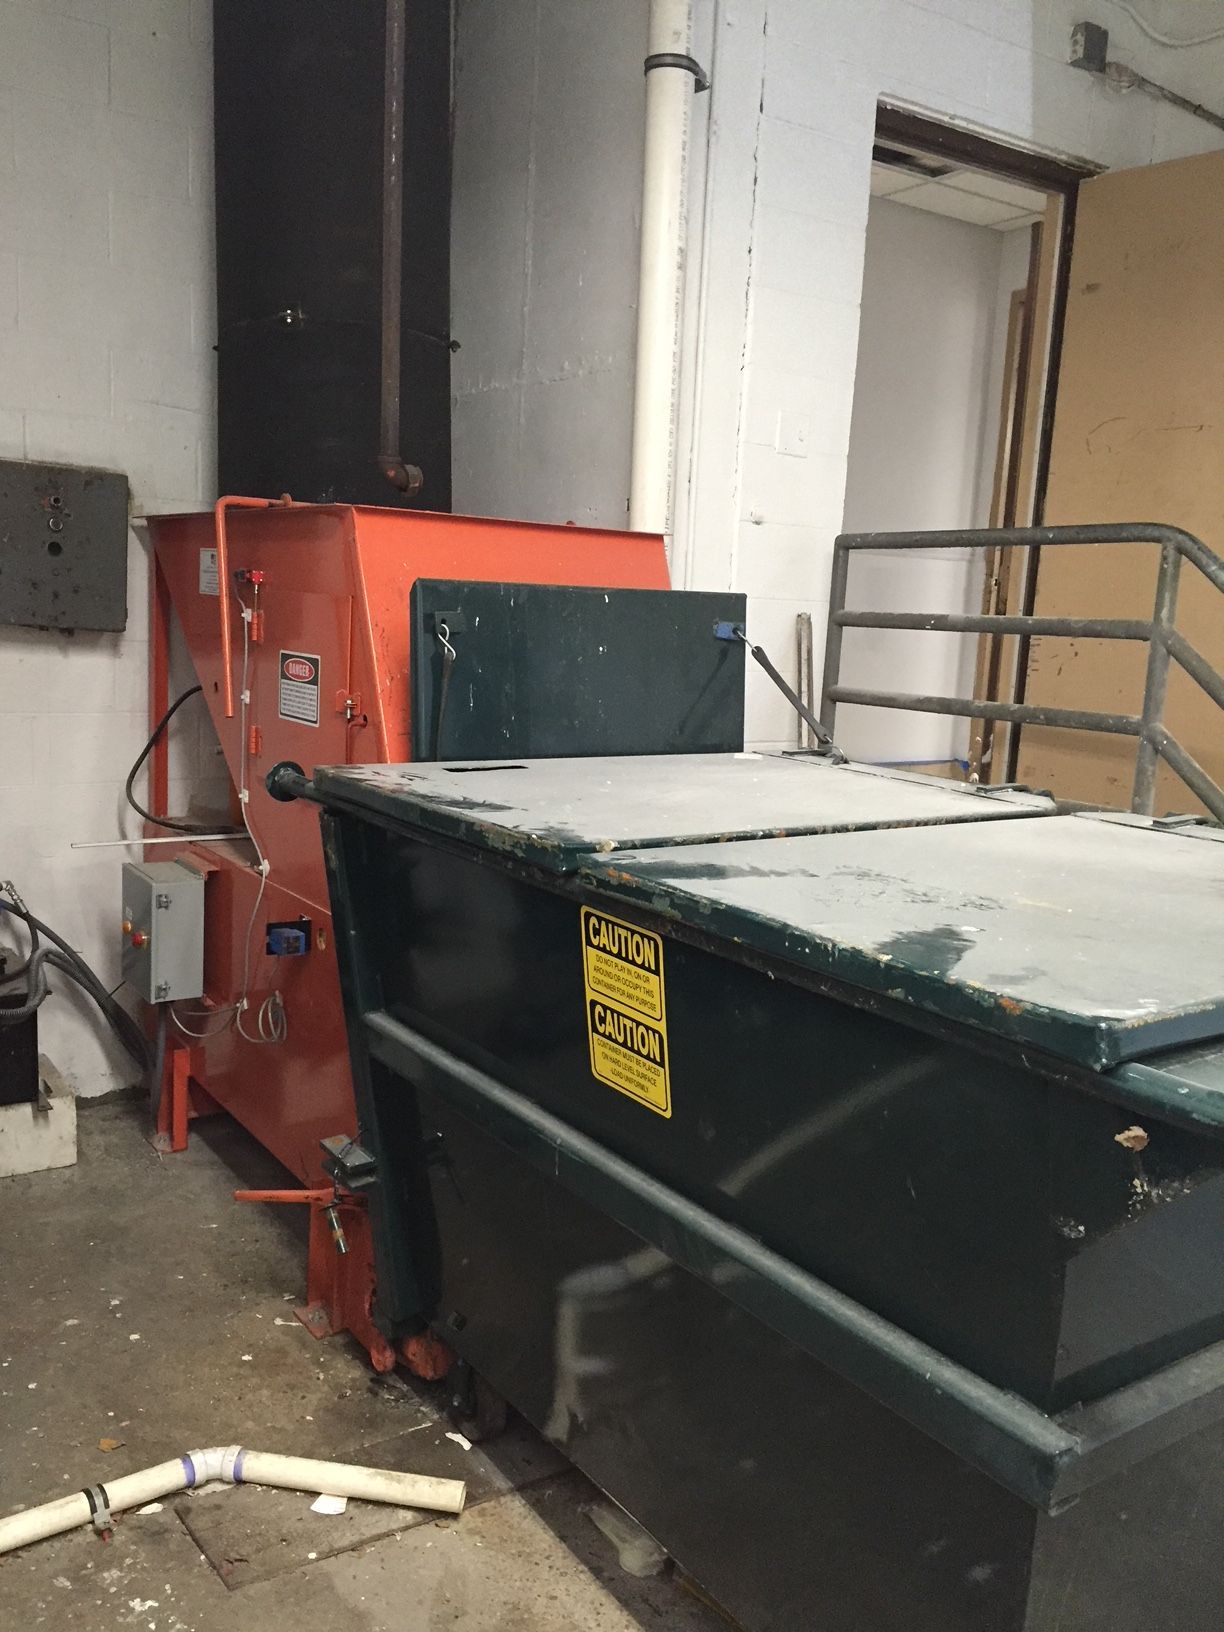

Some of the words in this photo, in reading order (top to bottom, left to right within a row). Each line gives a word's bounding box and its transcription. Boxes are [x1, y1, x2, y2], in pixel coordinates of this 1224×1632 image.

[589, 916, 656, 970] CAUTION
[593, 964, 613, 979] AROUND
[613, 973, 621, 983] OR
[621, 977, 641, 992] OCCUPY
[642, 986, 654, 998] THIS
[595, 953, 603, 963] DO
[603, 957, 613, 968] NOT
[614, 962, 625, 974] PLAY
[633, 970, 641, 980] ON
[642, 974, 649, 984] OR
[592, 975, 616, 992] CONTAINER
[616, 986, 625, 997] FOR
[626, 991, 635, 1002] ANY
[635, 996, 656, 1012] PURPOSE
[594, 1004, 660, 1062] CAUTION
[596, 1037, 621, 1057] CONTAINER
[622, 1050, 634, 1063] MUST
[635, 1057, 641, 1067] BE
[642, 1061, 660, 1077] PLACED
[601, 1051, 608, 1060] ON
[609, 1055, 621, 1067] HARD
[622, 1062, 634, 1075] LEVEL
[636, 1069, 656, 1087] SURFACE
[623, 1073, 648, 1093] UNIFORMLY
